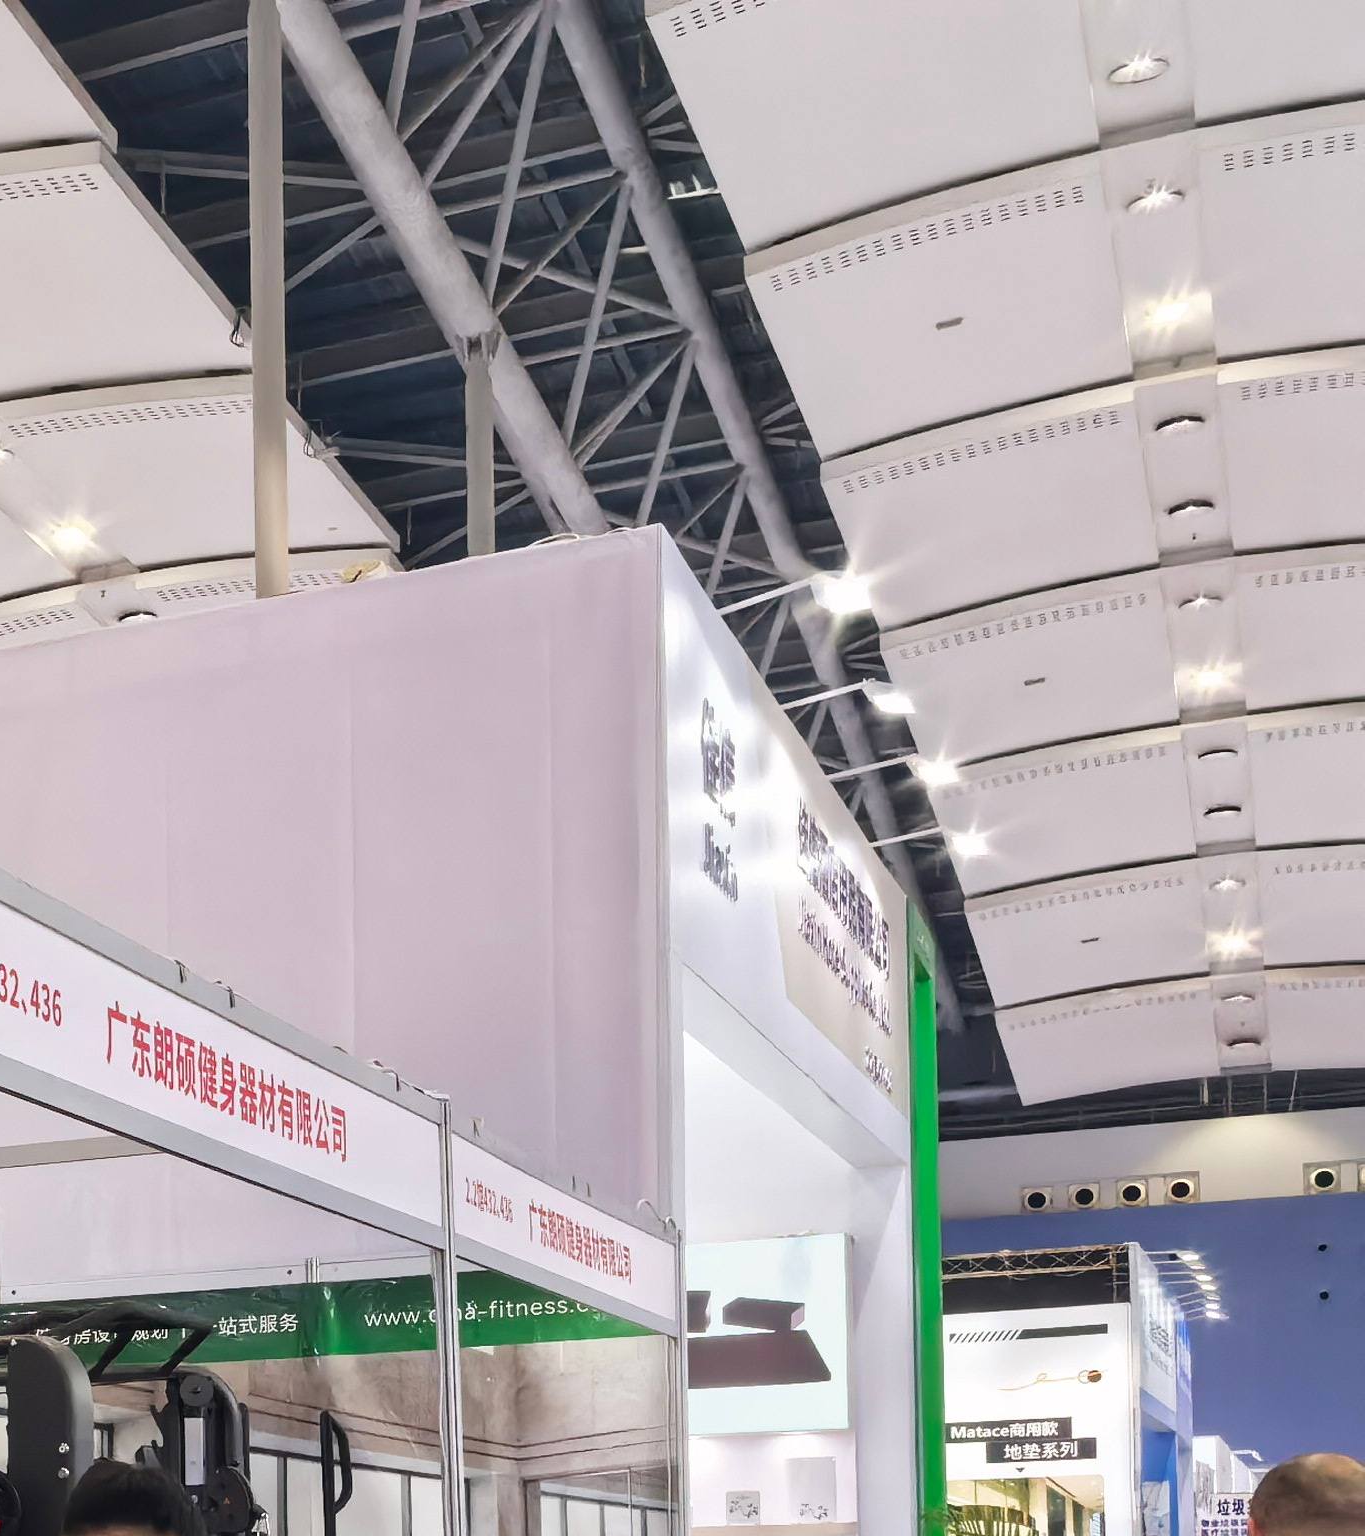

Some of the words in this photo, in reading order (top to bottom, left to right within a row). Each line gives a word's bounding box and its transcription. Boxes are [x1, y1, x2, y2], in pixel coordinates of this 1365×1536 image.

[107, 1003, 347, 1162] 广东朗硕健身器材有限公司
[213, 1313, 299, 1335] 站式服务
[1003, 1440, 1079, 1461] 地垫系列
[1217, 1498, 1253, 1516] 垃圾
